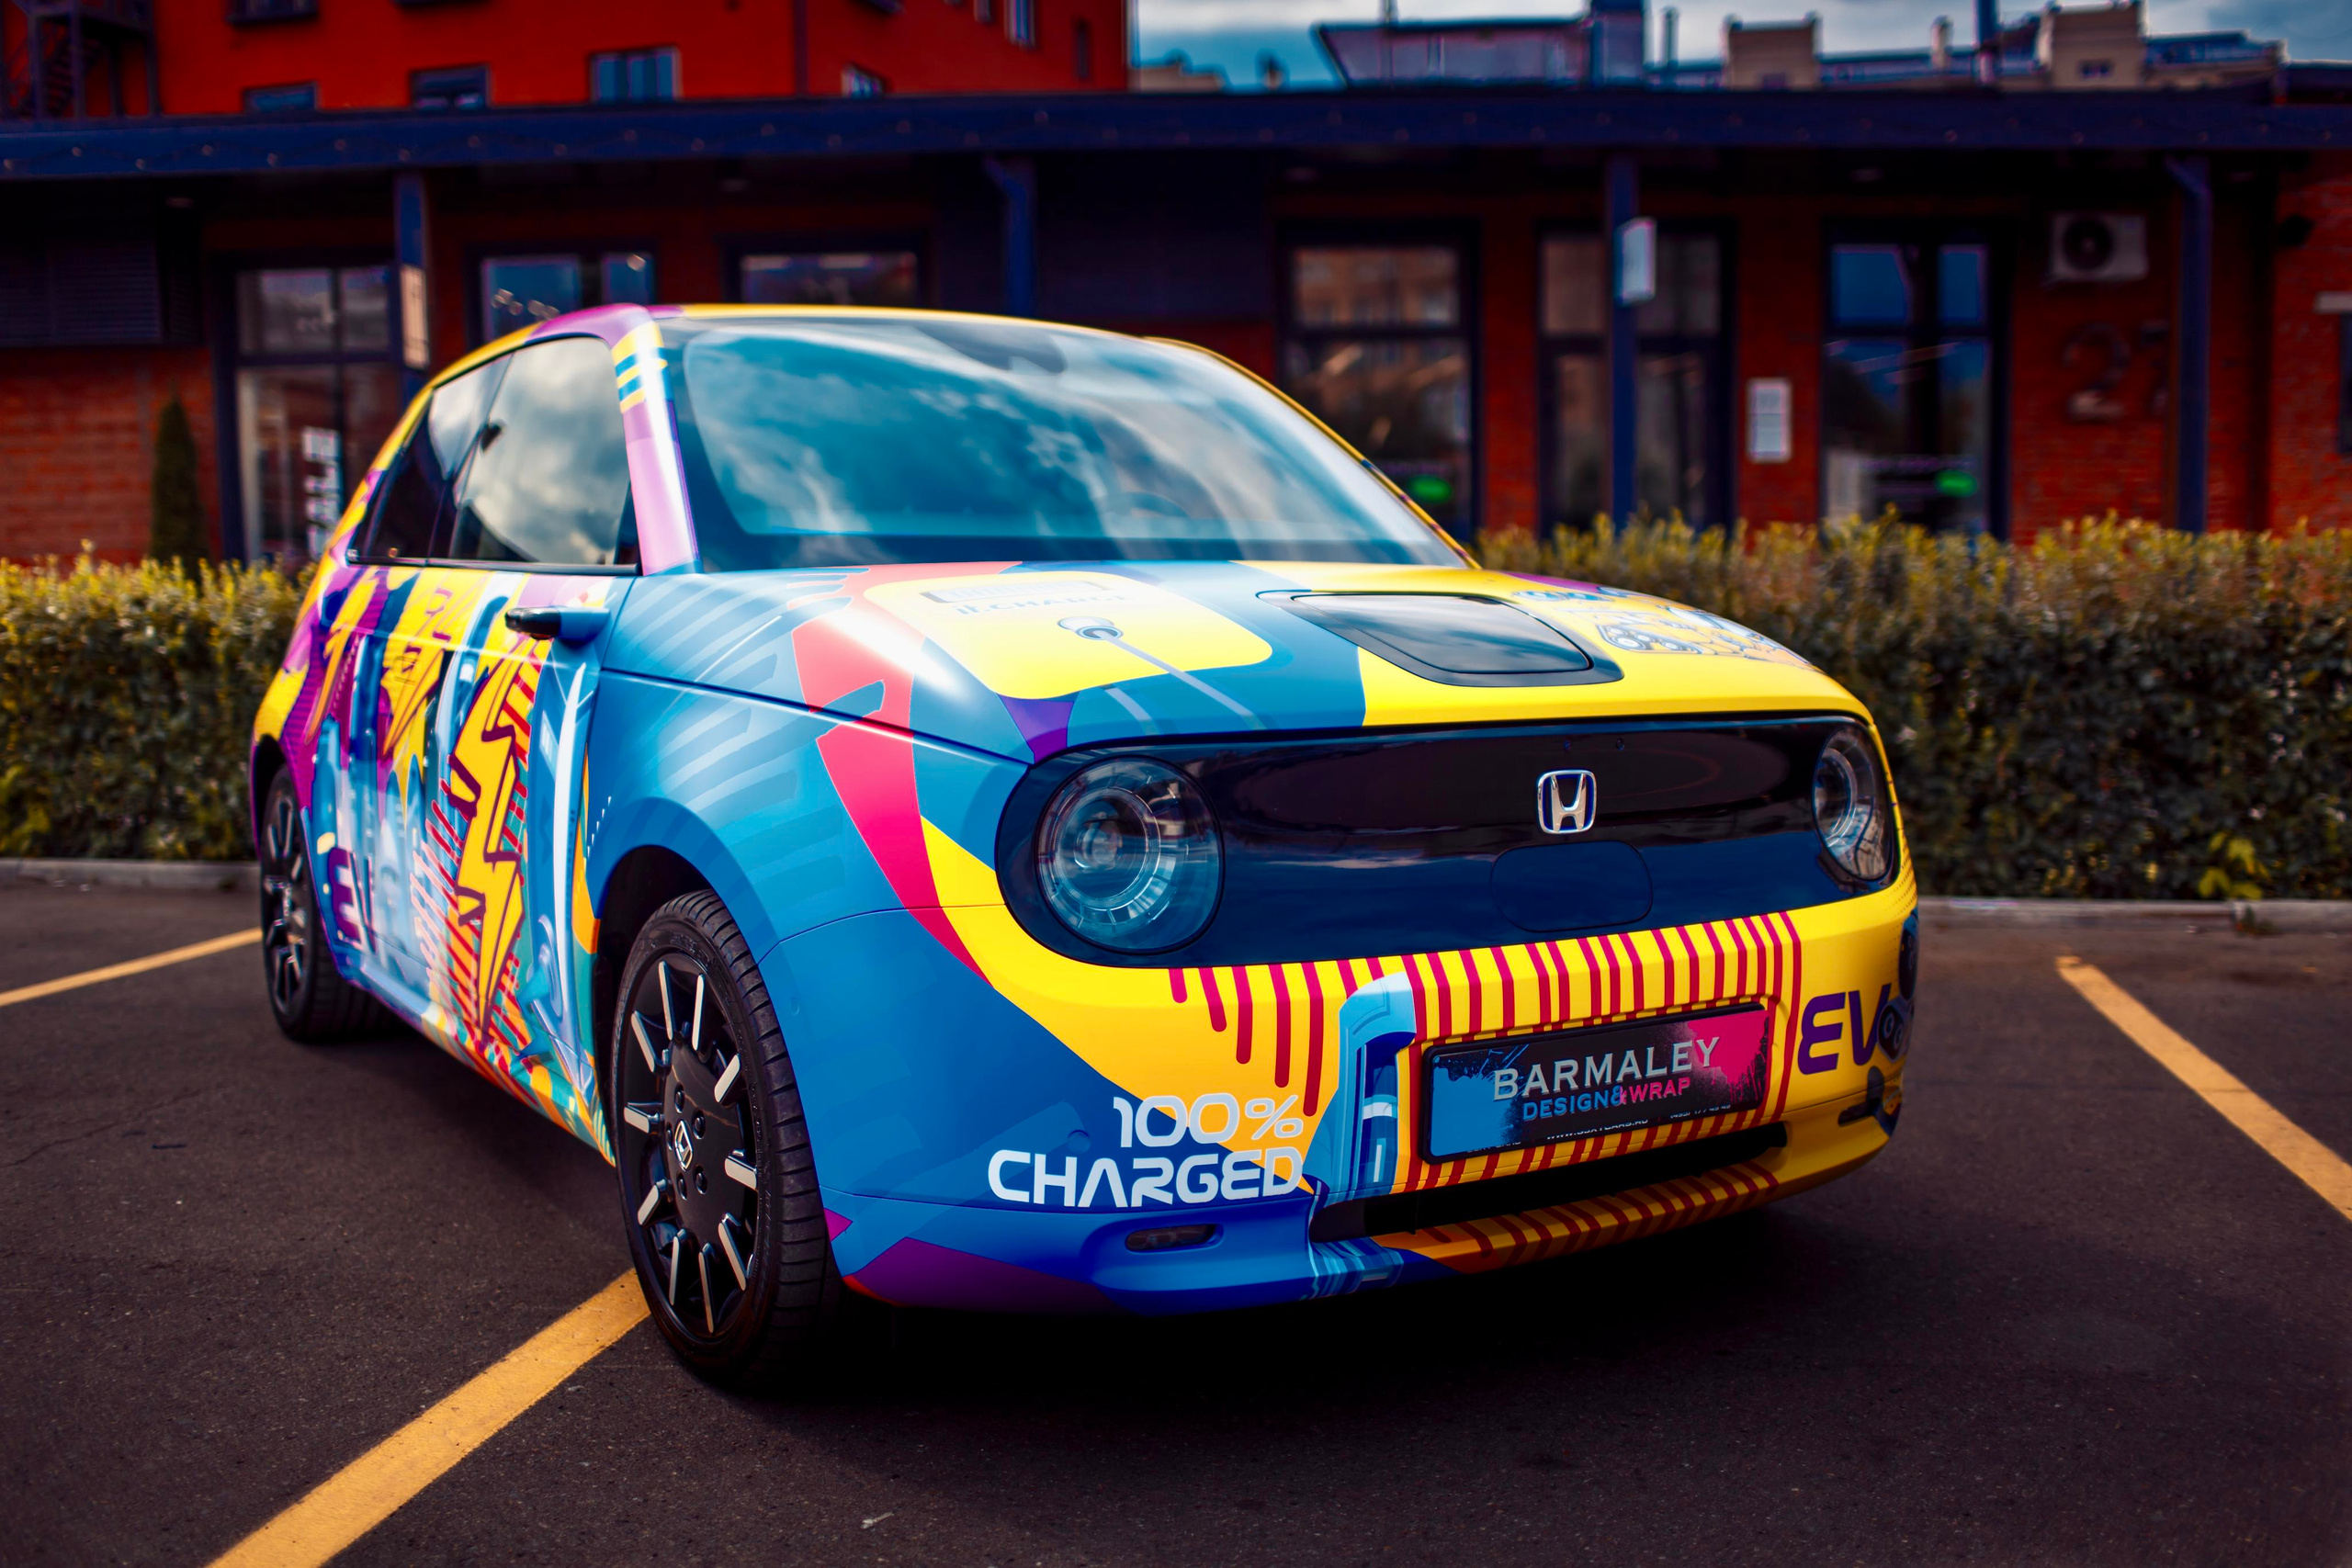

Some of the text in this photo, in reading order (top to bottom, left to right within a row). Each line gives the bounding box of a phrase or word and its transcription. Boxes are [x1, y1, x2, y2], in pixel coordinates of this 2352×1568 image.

[1493, 1037, 1720, 1101] BARMALEY
[1113, 1092, 1304, 1148] 100%
[988, 1146, 1303, 1208] CHARGED
